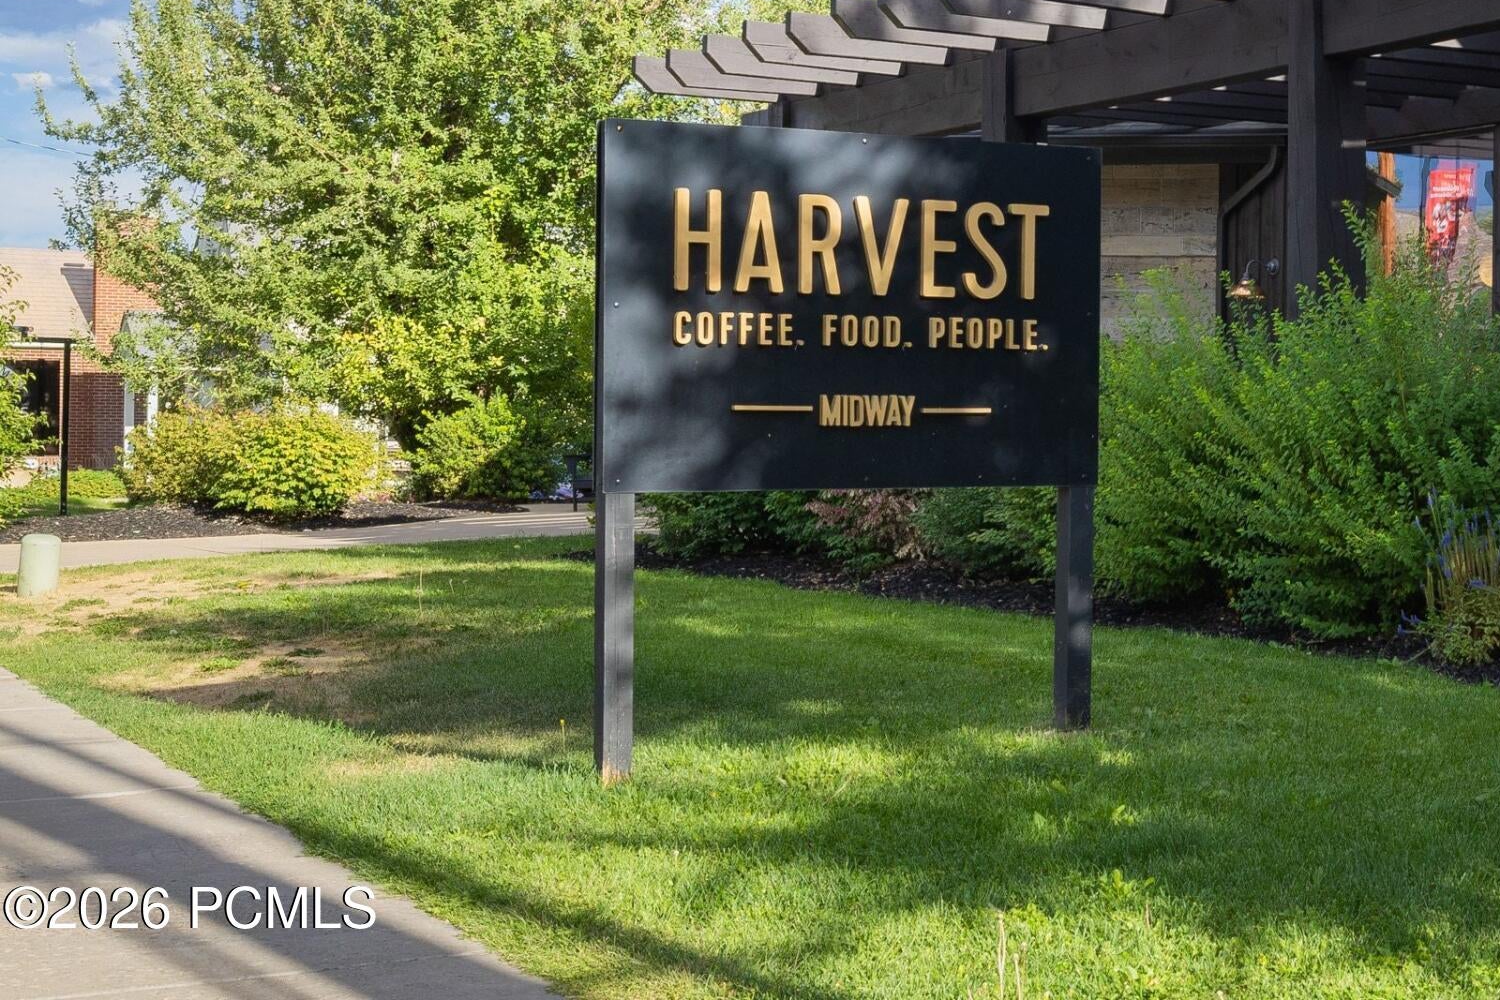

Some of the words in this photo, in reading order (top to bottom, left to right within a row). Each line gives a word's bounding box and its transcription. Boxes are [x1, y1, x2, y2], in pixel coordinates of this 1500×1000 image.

[673, 187, 1050, 299] HARVEST
[673, 311, 804, 346] COFFEE.
[822, 315, 913, 348] FOOD.
[928, 317, 1049, 351] PEOPLE.
[819, 395, 916, 427] MIDWAY
